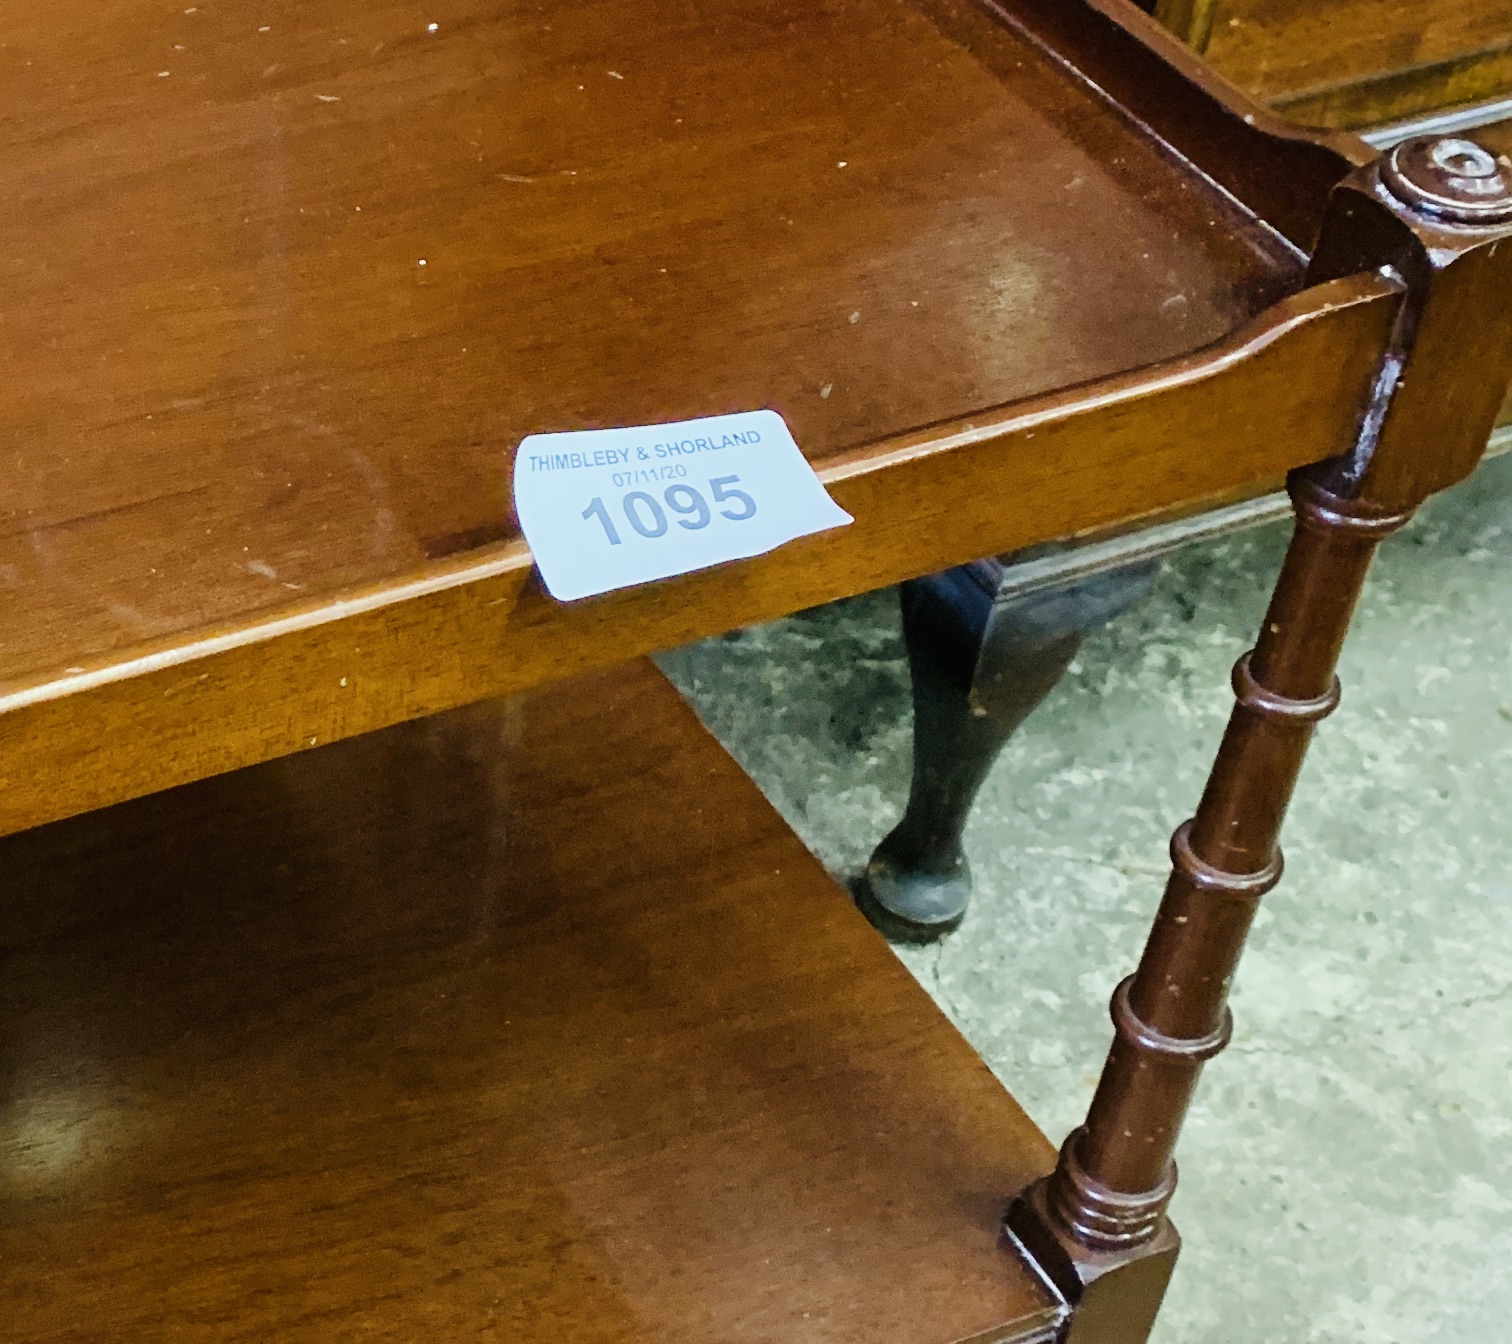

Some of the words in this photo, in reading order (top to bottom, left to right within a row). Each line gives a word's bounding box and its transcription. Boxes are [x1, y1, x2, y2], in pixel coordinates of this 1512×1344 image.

[529, 448, 631, 472] THIMBLEBY
[637, 446, 650, 460] &
[655, 430, 761, 458] SHORLAND
[612, 464, 687, 487] 07/11/20
[581, 474, 757, 545] 1095
